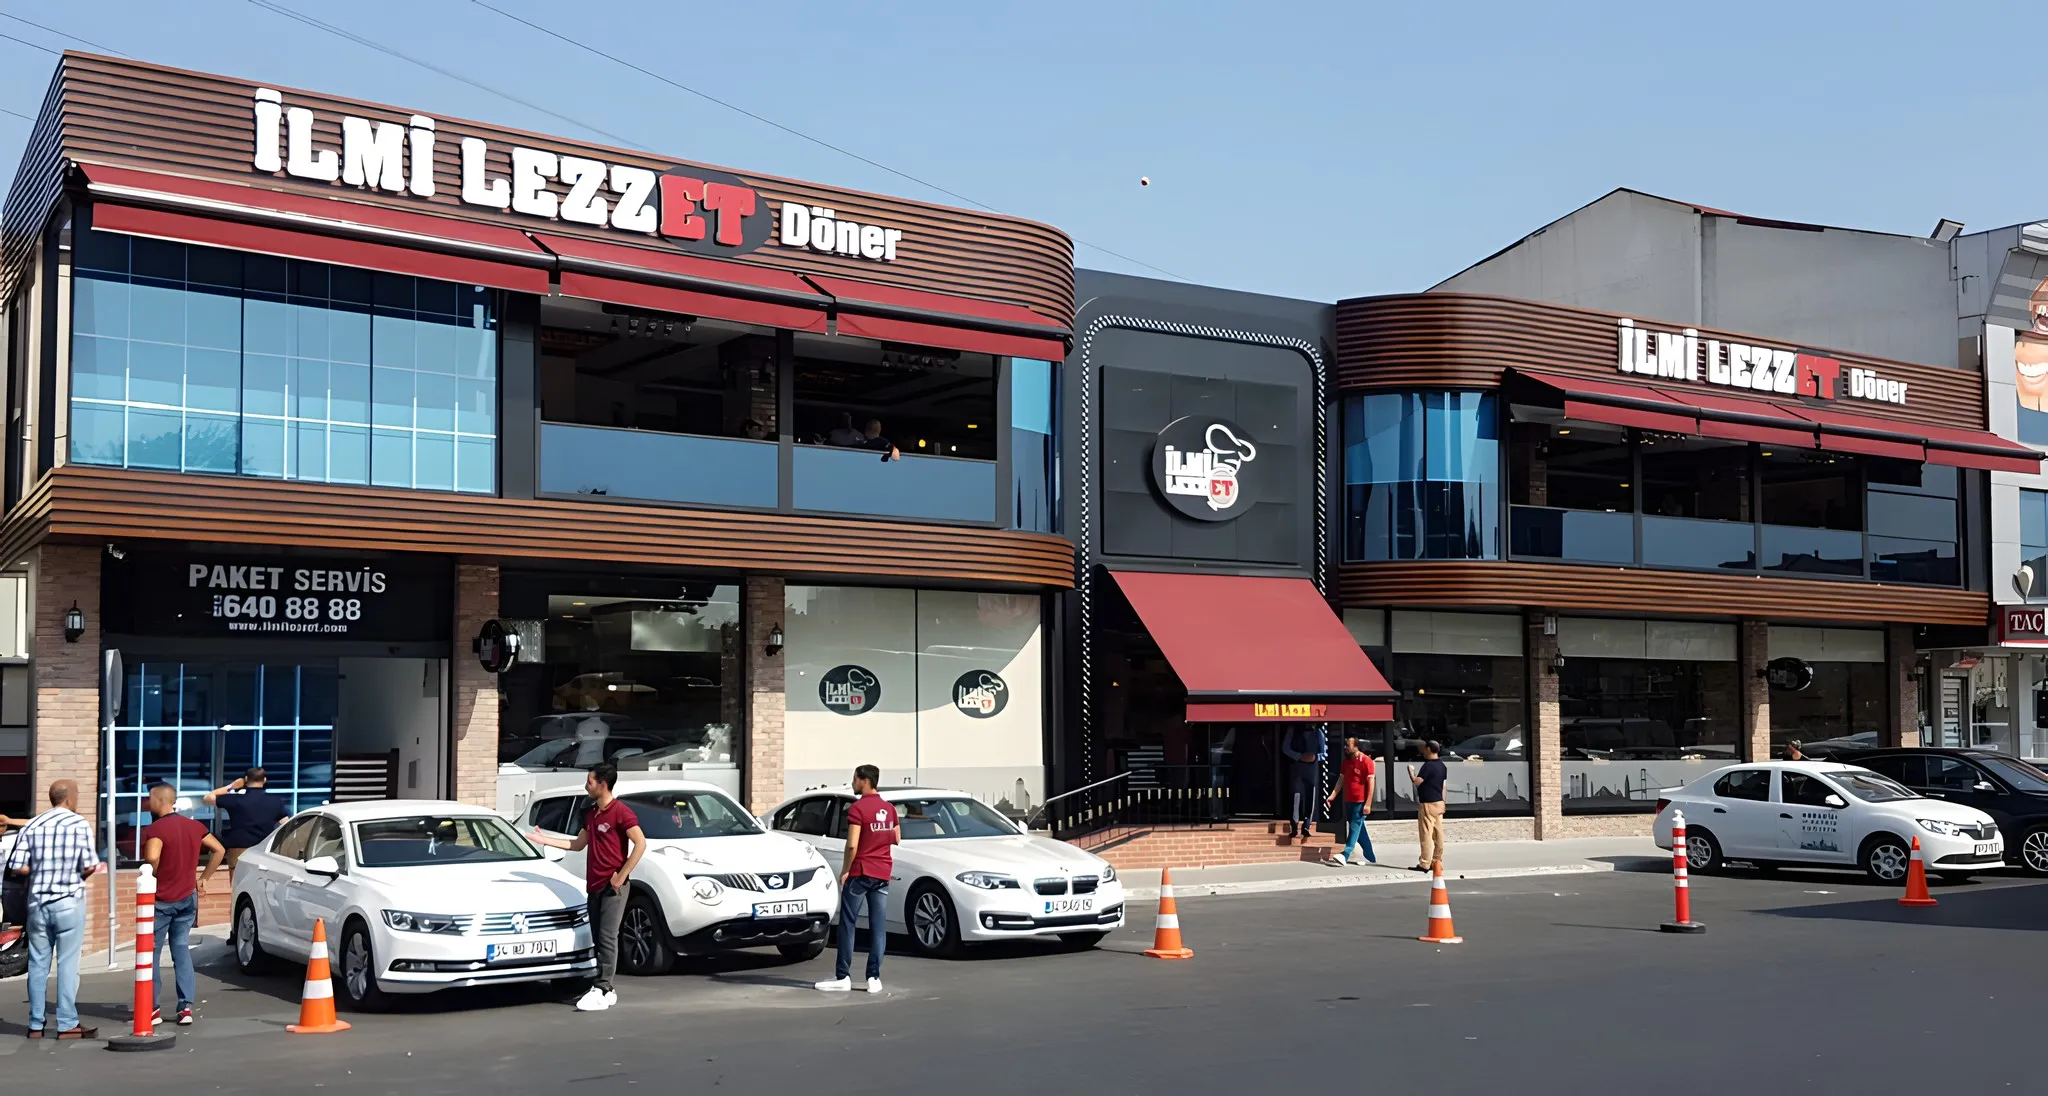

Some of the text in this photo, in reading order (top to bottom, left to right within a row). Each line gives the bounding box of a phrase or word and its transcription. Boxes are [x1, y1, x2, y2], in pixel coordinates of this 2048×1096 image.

[254, 87, 902, 262] İLMİ LEZZET Döner
[1618, 318, 1908, 405] İLMİ LEZZET Döner
[189, 564, 386, 593] PAKET SERVİS
[223, 595, 277, 618] 640
[285, 597, 319, 620] 88
[328, 598, 361, 621] 88
